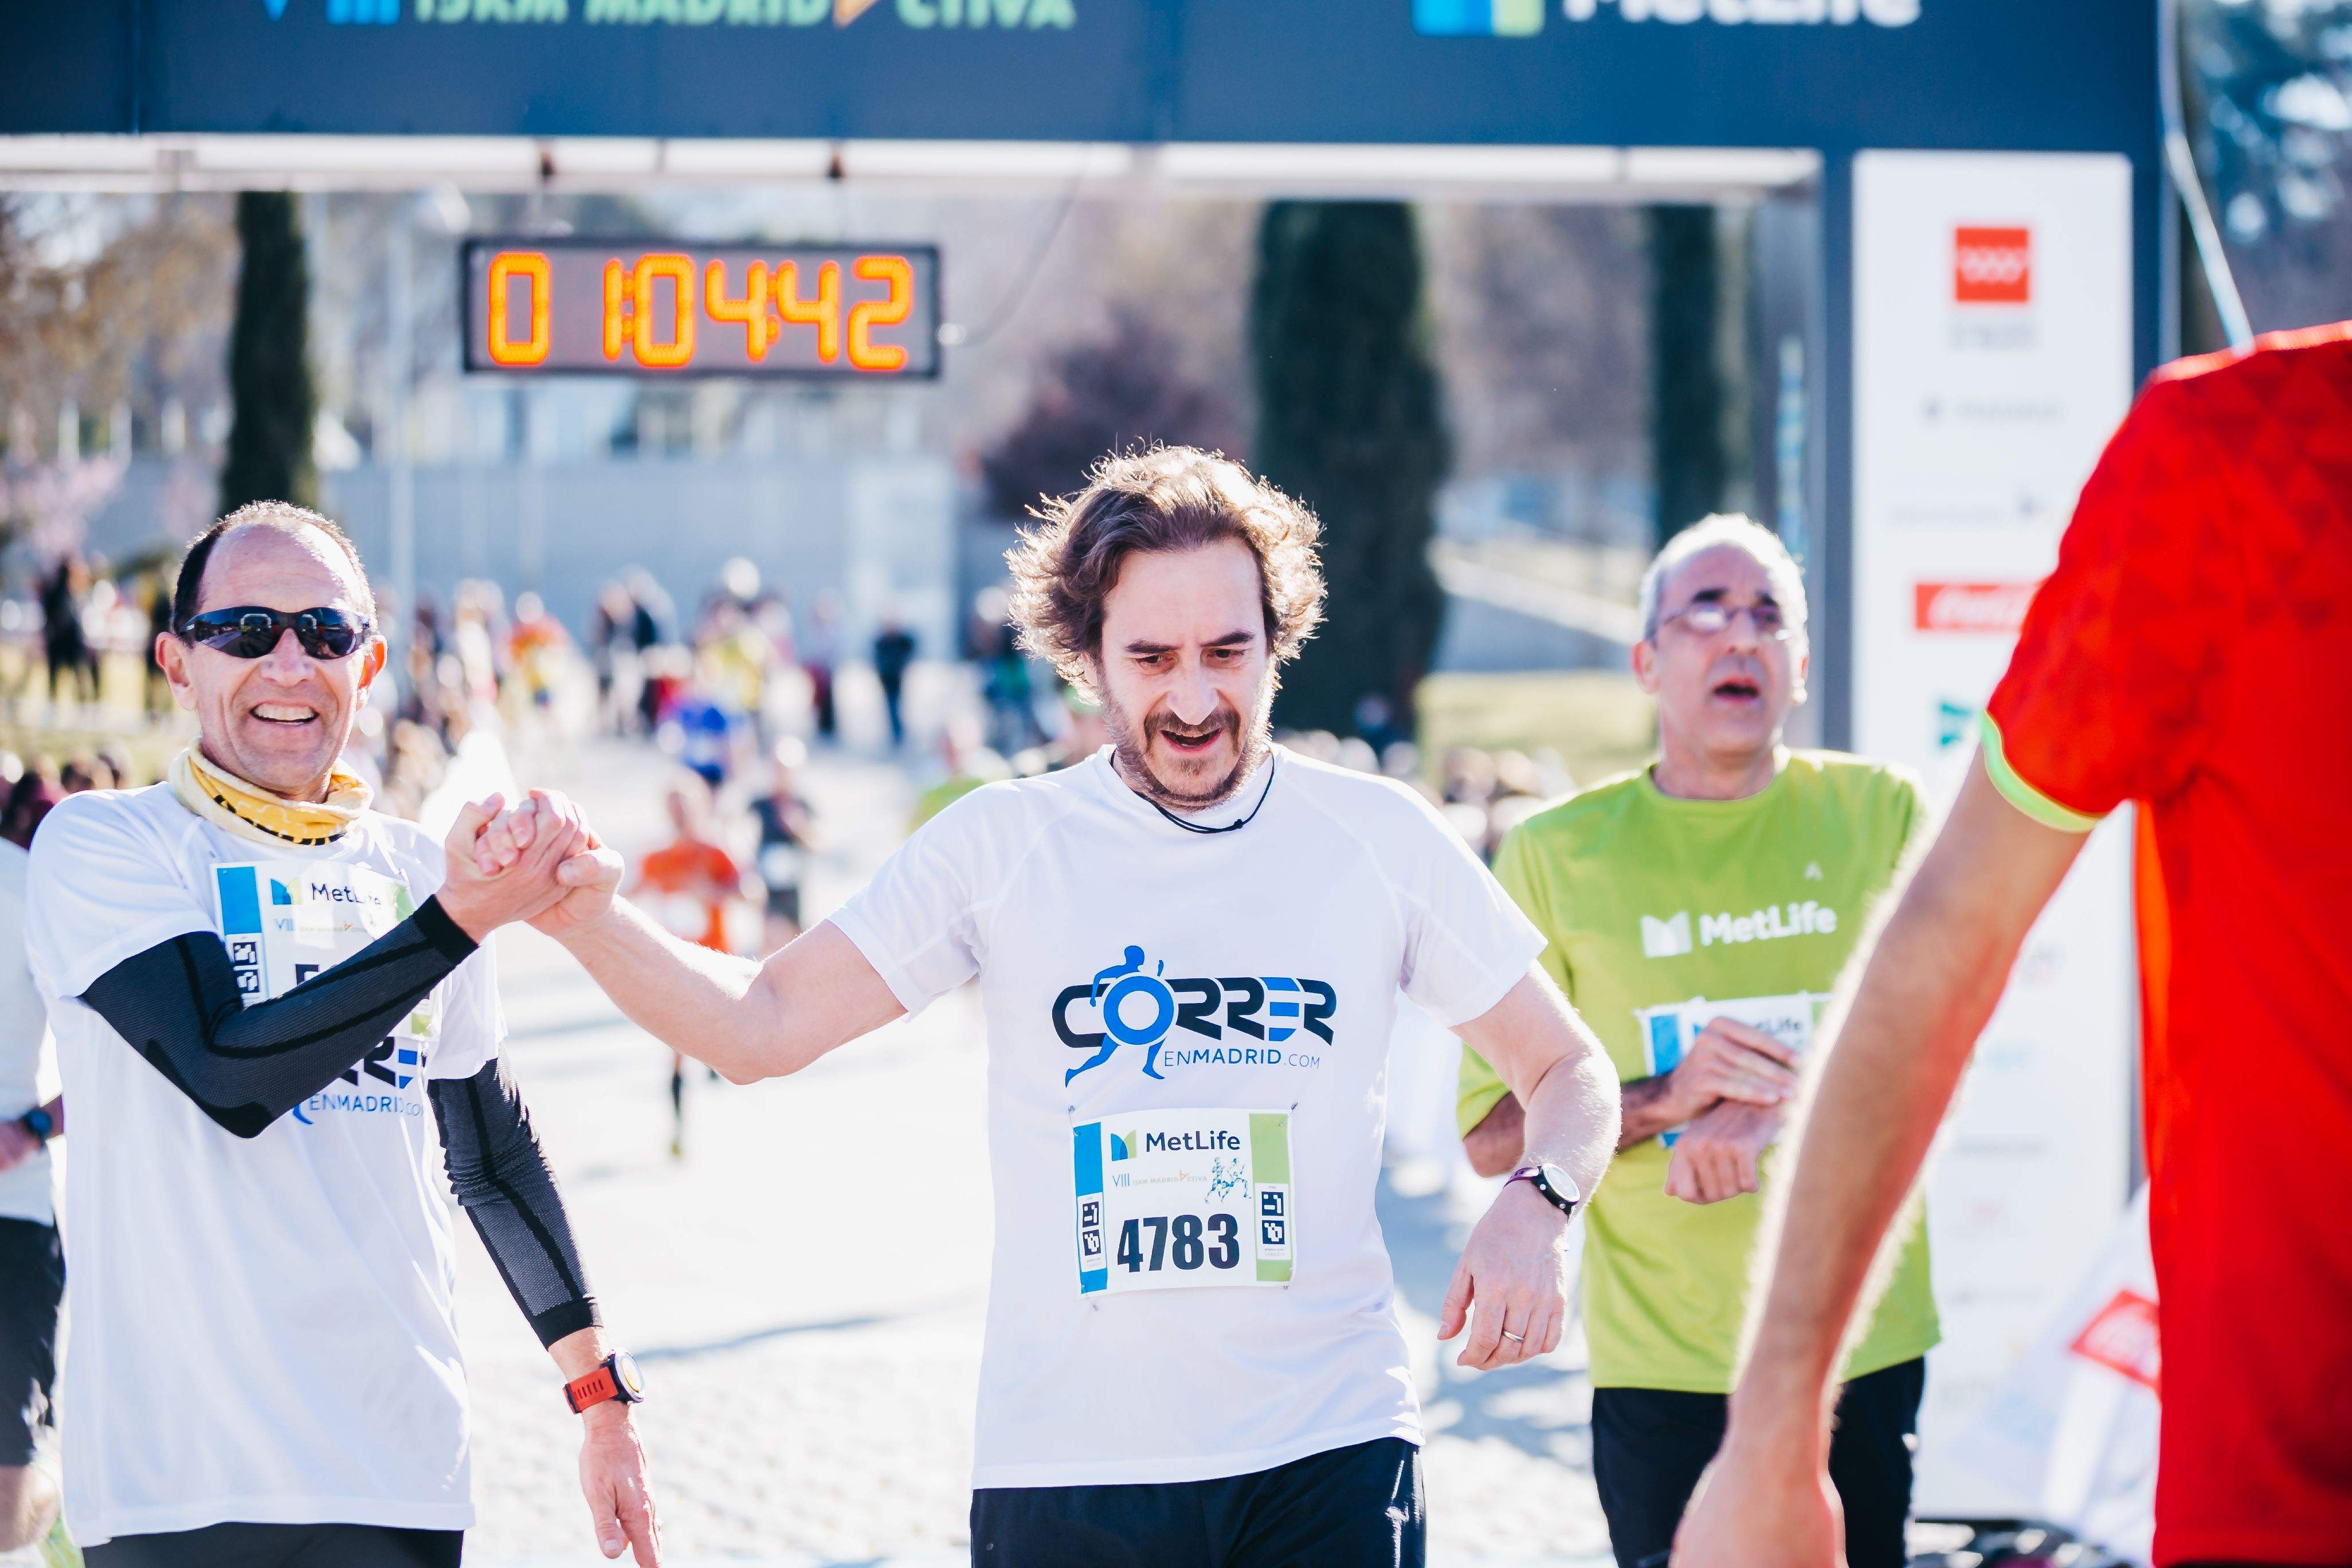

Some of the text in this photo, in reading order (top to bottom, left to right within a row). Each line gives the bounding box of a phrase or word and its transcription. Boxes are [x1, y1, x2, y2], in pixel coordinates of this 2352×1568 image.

[1699, 900, 1837, 947] MetLife
[1052, 975, 1337, 1048] CORRER
[1164, 1048, 1321, 1070] ENMADRID.COM
[1146, 1130, 1241, 1153] MetLife
[1112, 1173, 1130, 1188] VIII
[1116, 1213, 1240, 1273] 4783
